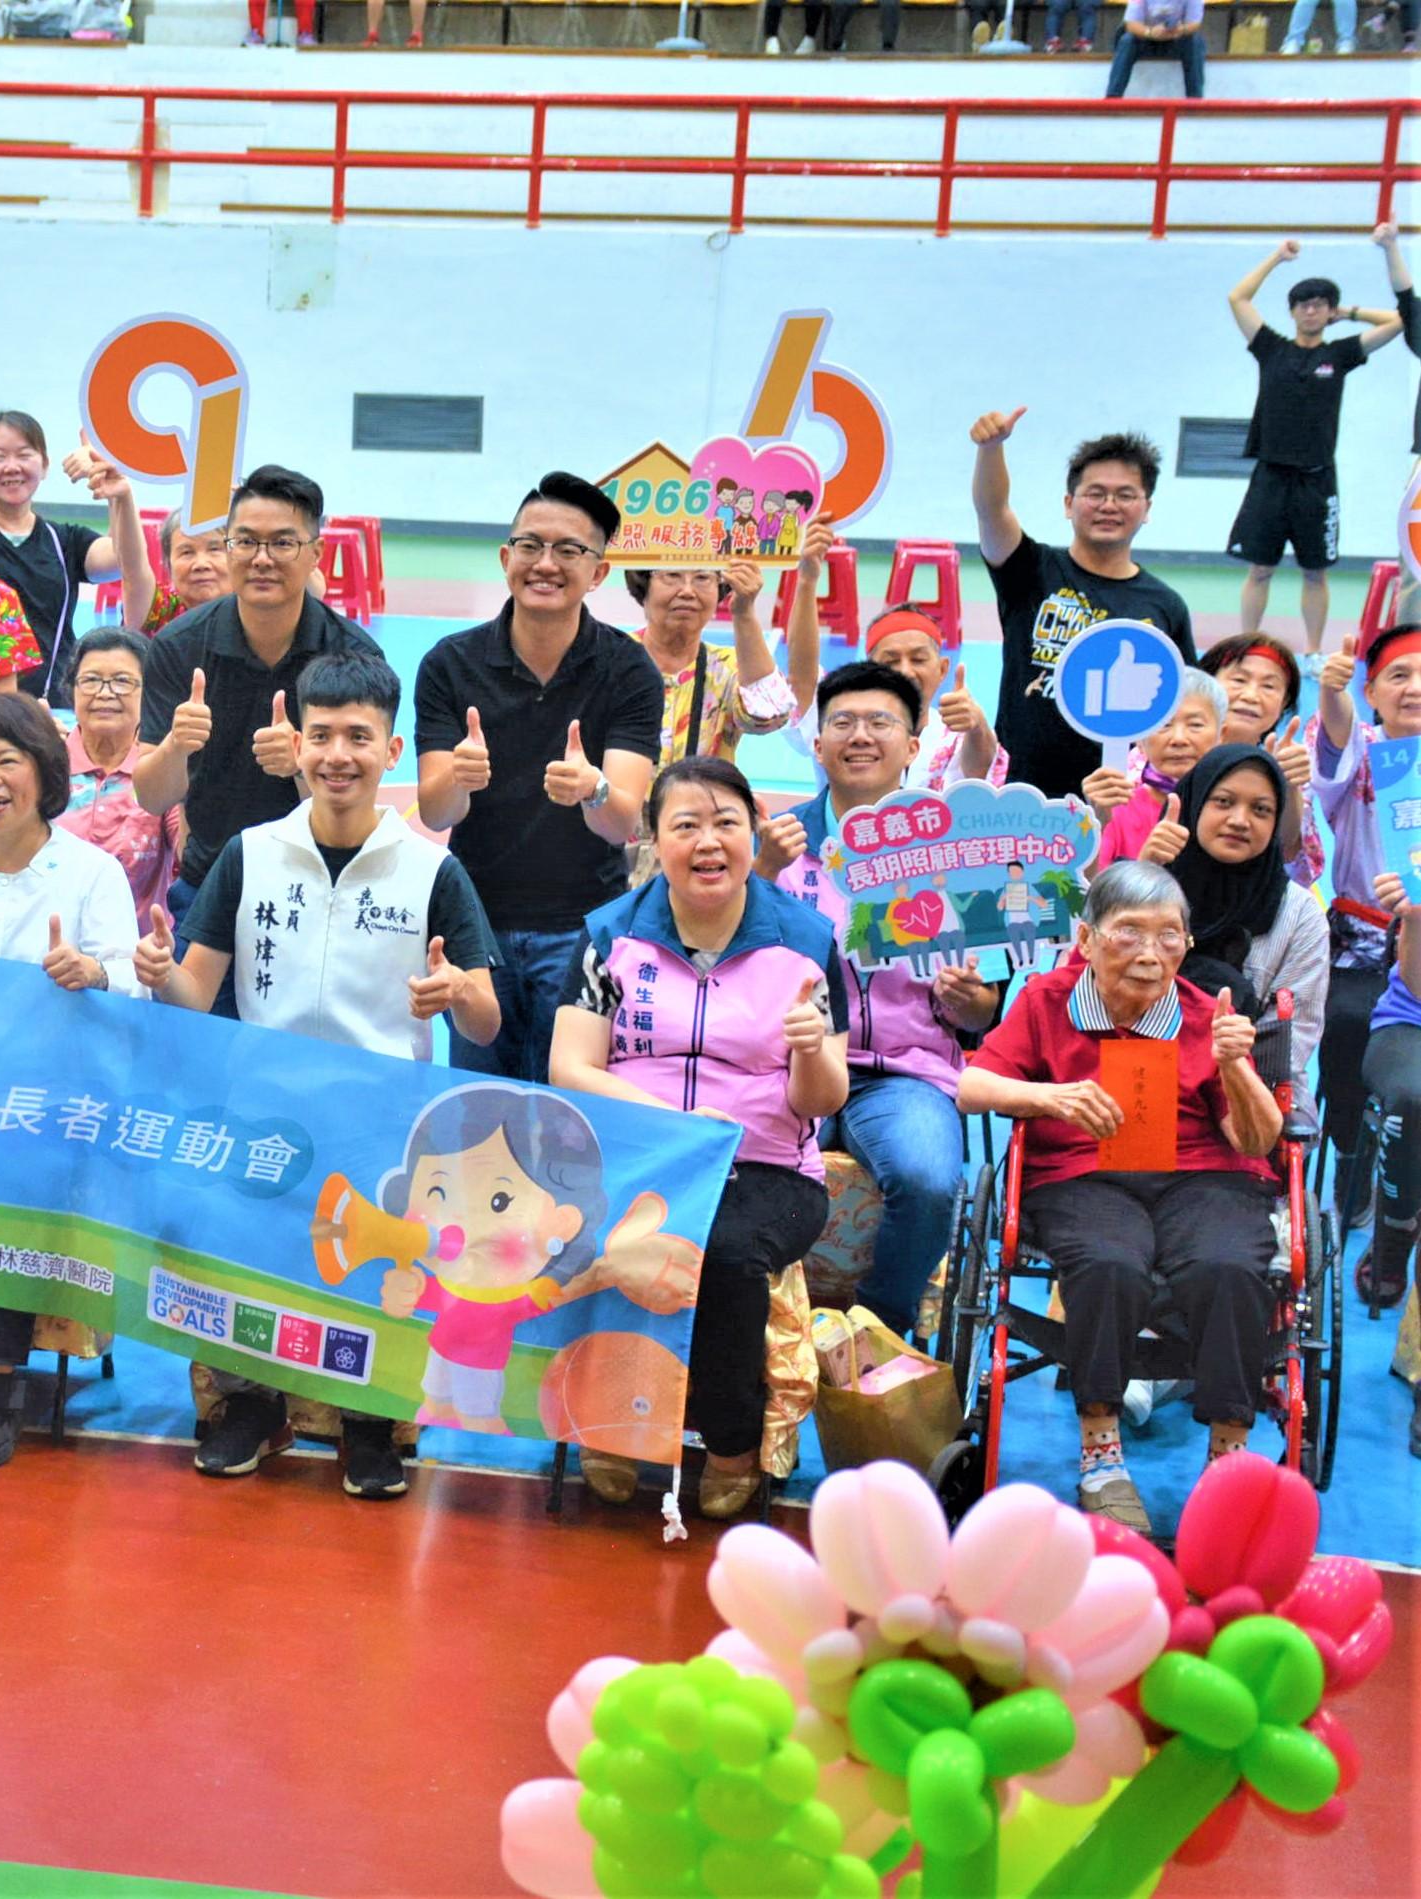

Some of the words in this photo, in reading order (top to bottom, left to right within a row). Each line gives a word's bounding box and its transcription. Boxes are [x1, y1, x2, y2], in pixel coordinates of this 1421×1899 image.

[86, 319, 243, 530] 9
[607, 519, 758, 549] 照服務專線
[1032, 645, 1062, 663] 202
[1380, 749, 1410, 768] 14
[850, 806, 942, 848] 嘉義市
[959, 811, 1023, 831] CHIAYI
[1028, 813, 1072, 831] CITY
[846, 835, 1076, 892] 長期照顧管理中心
[285, 883, 307, 933] 議員
[154, 1284, 226, 1317] DEVELOPMENT
[155, 1273, 227, 1307] SUSTAINABLE
[152, 1296, 226, 1338] GOALS
